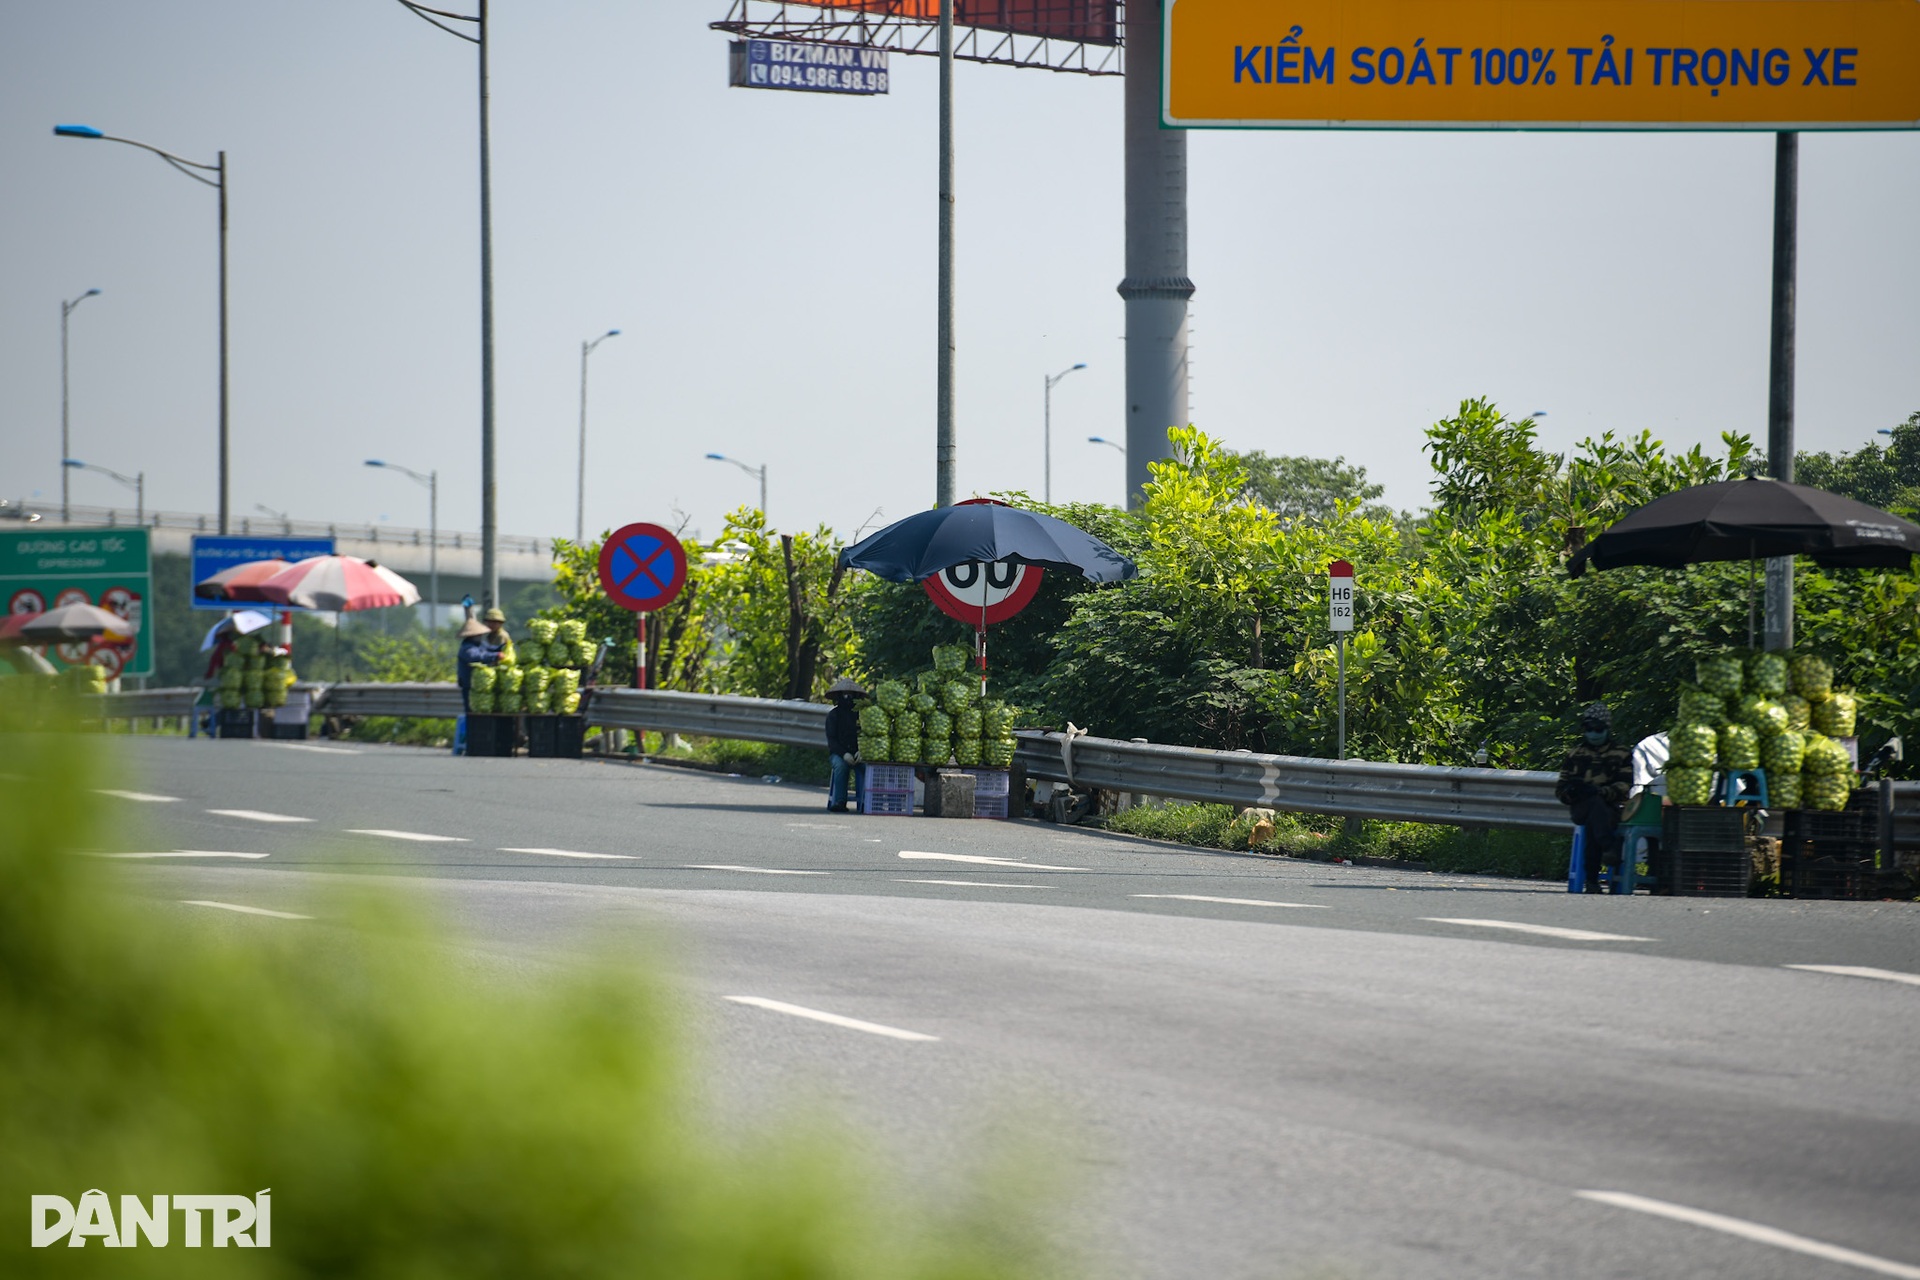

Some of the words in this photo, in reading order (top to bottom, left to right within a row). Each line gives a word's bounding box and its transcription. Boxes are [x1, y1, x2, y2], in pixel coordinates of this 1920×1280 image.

[770, 43, 887, 69] BIZMAN.VN
[1234, 26, 1334, 84] KIỂM
[1350, 38, 1462, 85] SOÁT
[1471, 48, 1556, 85] 100%
[1568, 35, 1633, 86] TẢI
[1646, 47, 1790, 97] TRỌNG
[1804, 48, 1858, 86] XE
[770, 64, 887, 91] 094.986.98.98
[1332, 588, 1350, 600] H6
[1333, 607, 1351, 617] 162
